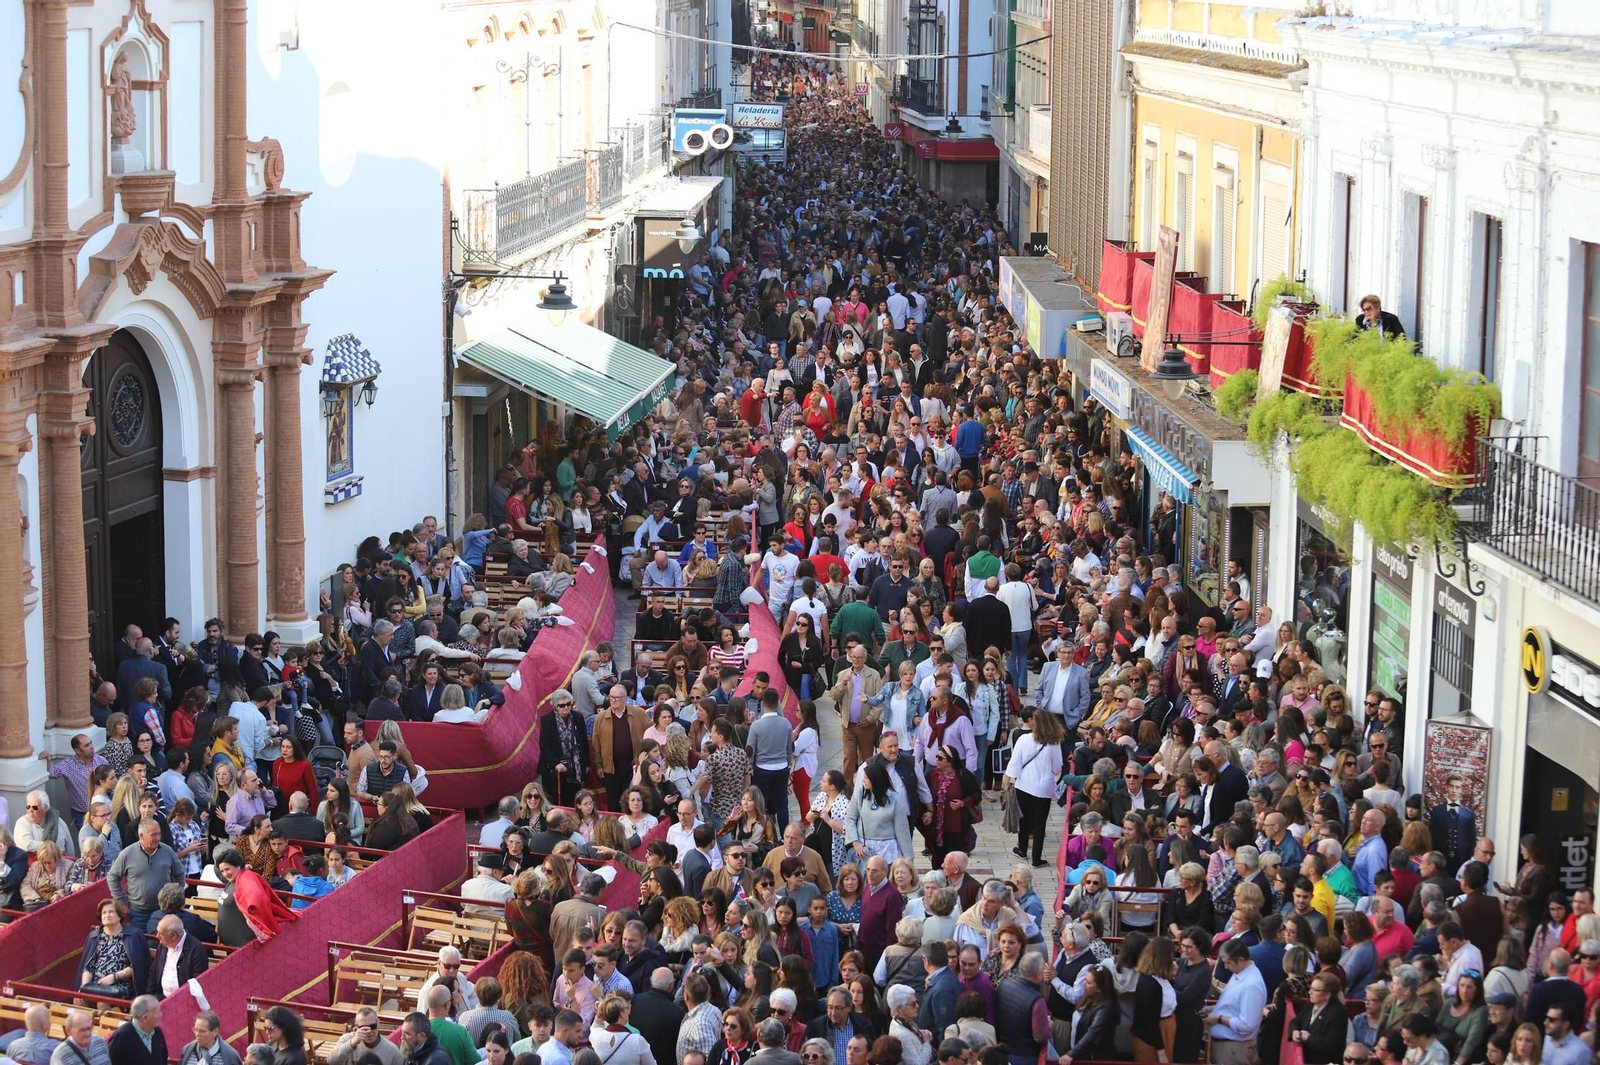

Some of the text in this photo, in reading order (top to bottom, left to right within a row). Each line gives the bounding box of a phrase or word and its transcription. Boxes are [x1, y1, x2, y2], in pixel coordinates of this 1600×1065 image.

[1033, 244, 1049, 252] MA
[1390, 551, 1408, 580] prieto
[1438, 586, 1470, 626] artenovia
[1560, 836, 1589, 906] utlet
